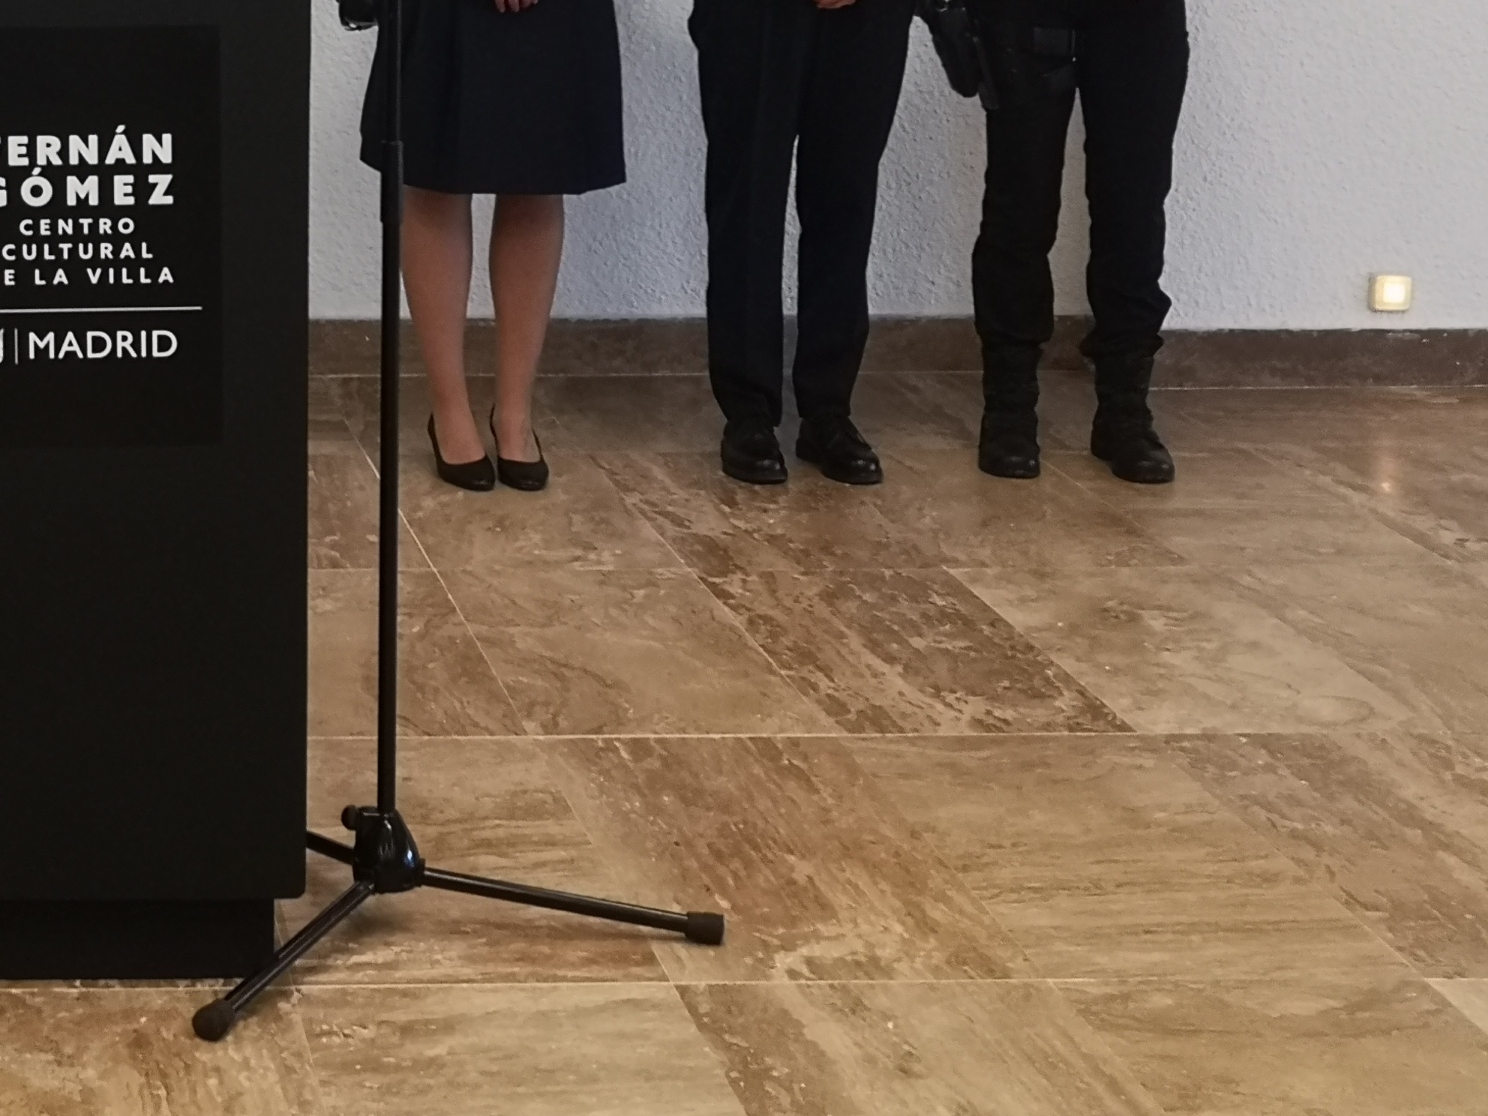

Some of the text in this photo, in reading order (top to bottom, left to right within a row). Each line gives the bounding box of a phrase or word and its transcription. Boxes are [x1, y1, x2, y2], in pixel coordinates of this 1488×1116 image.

[19, 217, 135, 236] CENTRO
[1, 242, 154, 261] CULTURAL
[34, 268, 69, 286] LA
[86, 266, 174, 285] VILLA
[28, 329, 178, 360] MADRID
